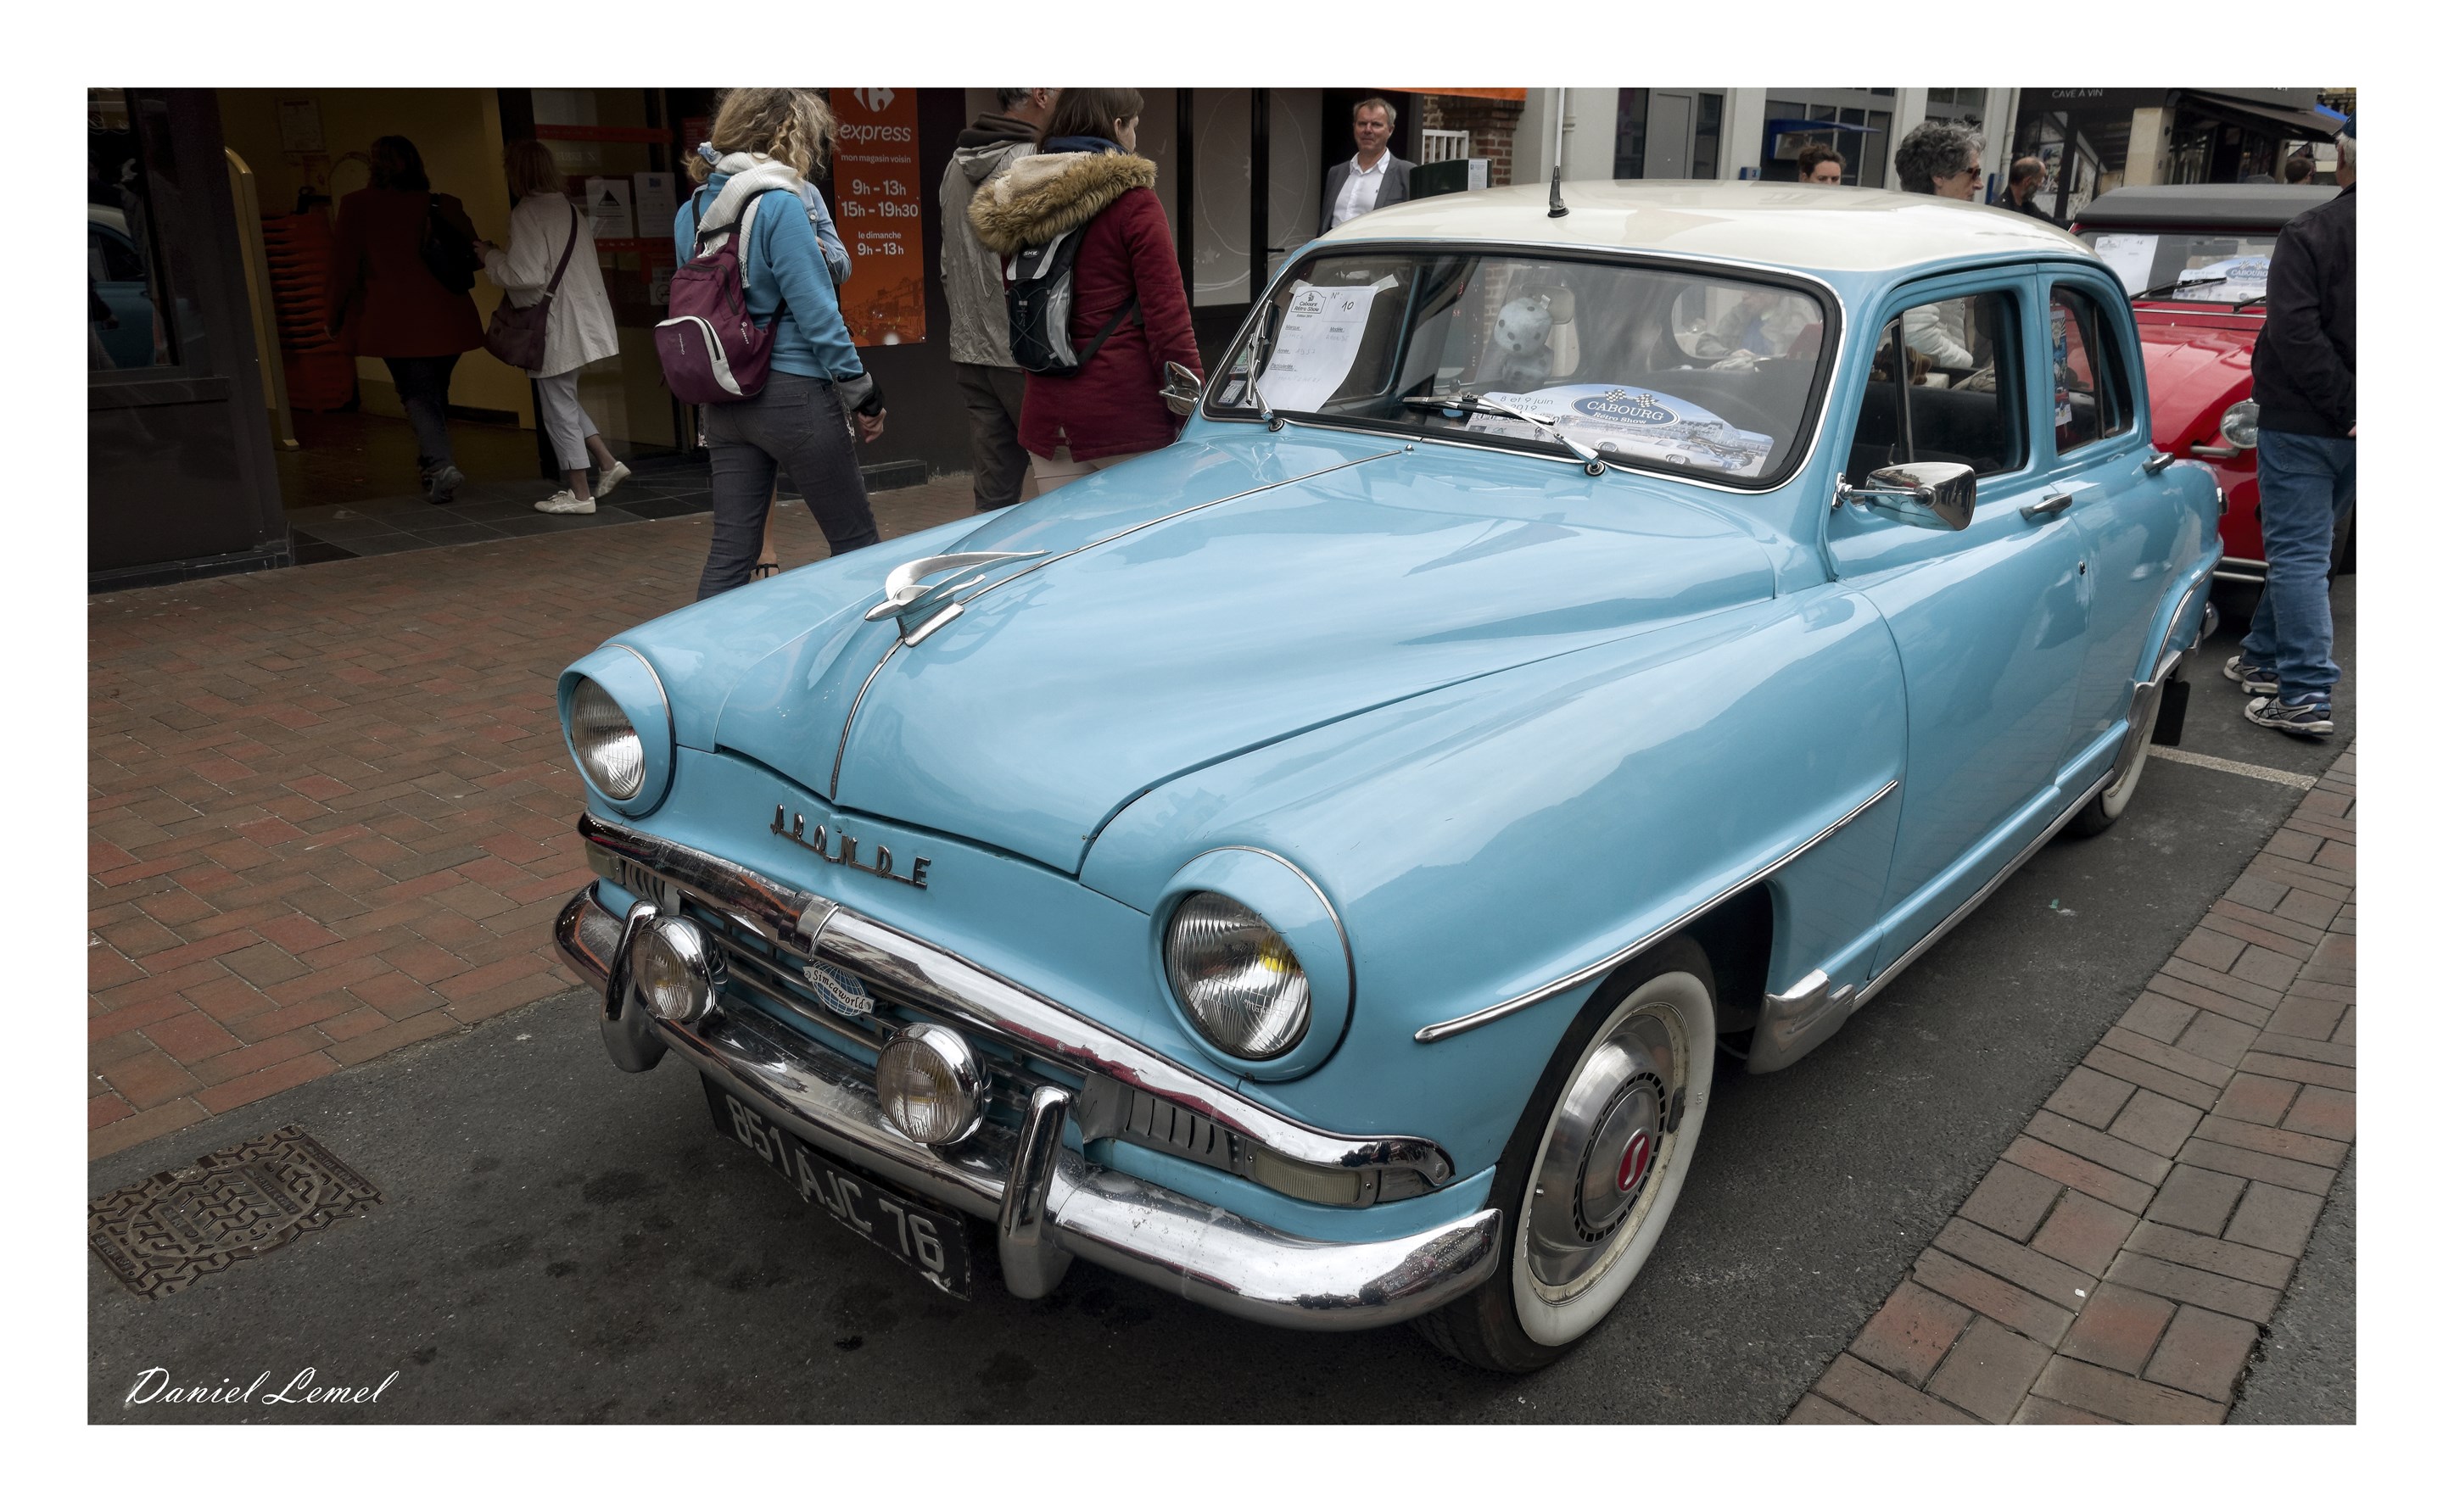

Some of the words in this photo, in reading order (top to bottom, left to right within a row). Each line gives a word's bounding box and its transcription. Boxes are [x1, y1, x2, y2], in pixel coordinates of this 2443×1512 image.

[2052, 89, 2077, 98] CAVE
[2088, 88, 2103, 98] VIN
[840, 124, 911, 145] express
[859, 154, 889, 164] magasin
[890, 154, 911, 164] voisin
[852, 179, 870, 196] 9h
[883, 180, 906, 196] 13h
[841, 201, 865, 217] 15h
[878, 201, 918, 217] 19h30
[866, 231, 902, 239] dimanche
[858, 243, 873, 255] 9h
[883, 243, 904, 255] 13h
[1341, 301, 1355, 312] 10
[1587, 400, 1664, 421] CABOURG
[1593, 411, 1618, 421] Rétro
[770, 804, 931, 890] ARONDE
[813, 969, 865, 1010] Simcaworld
[726, 1094, 791, 1177] 851
[795, 1148, 873, 1232] AJC
[879, 1198, 945, 1273] 76
